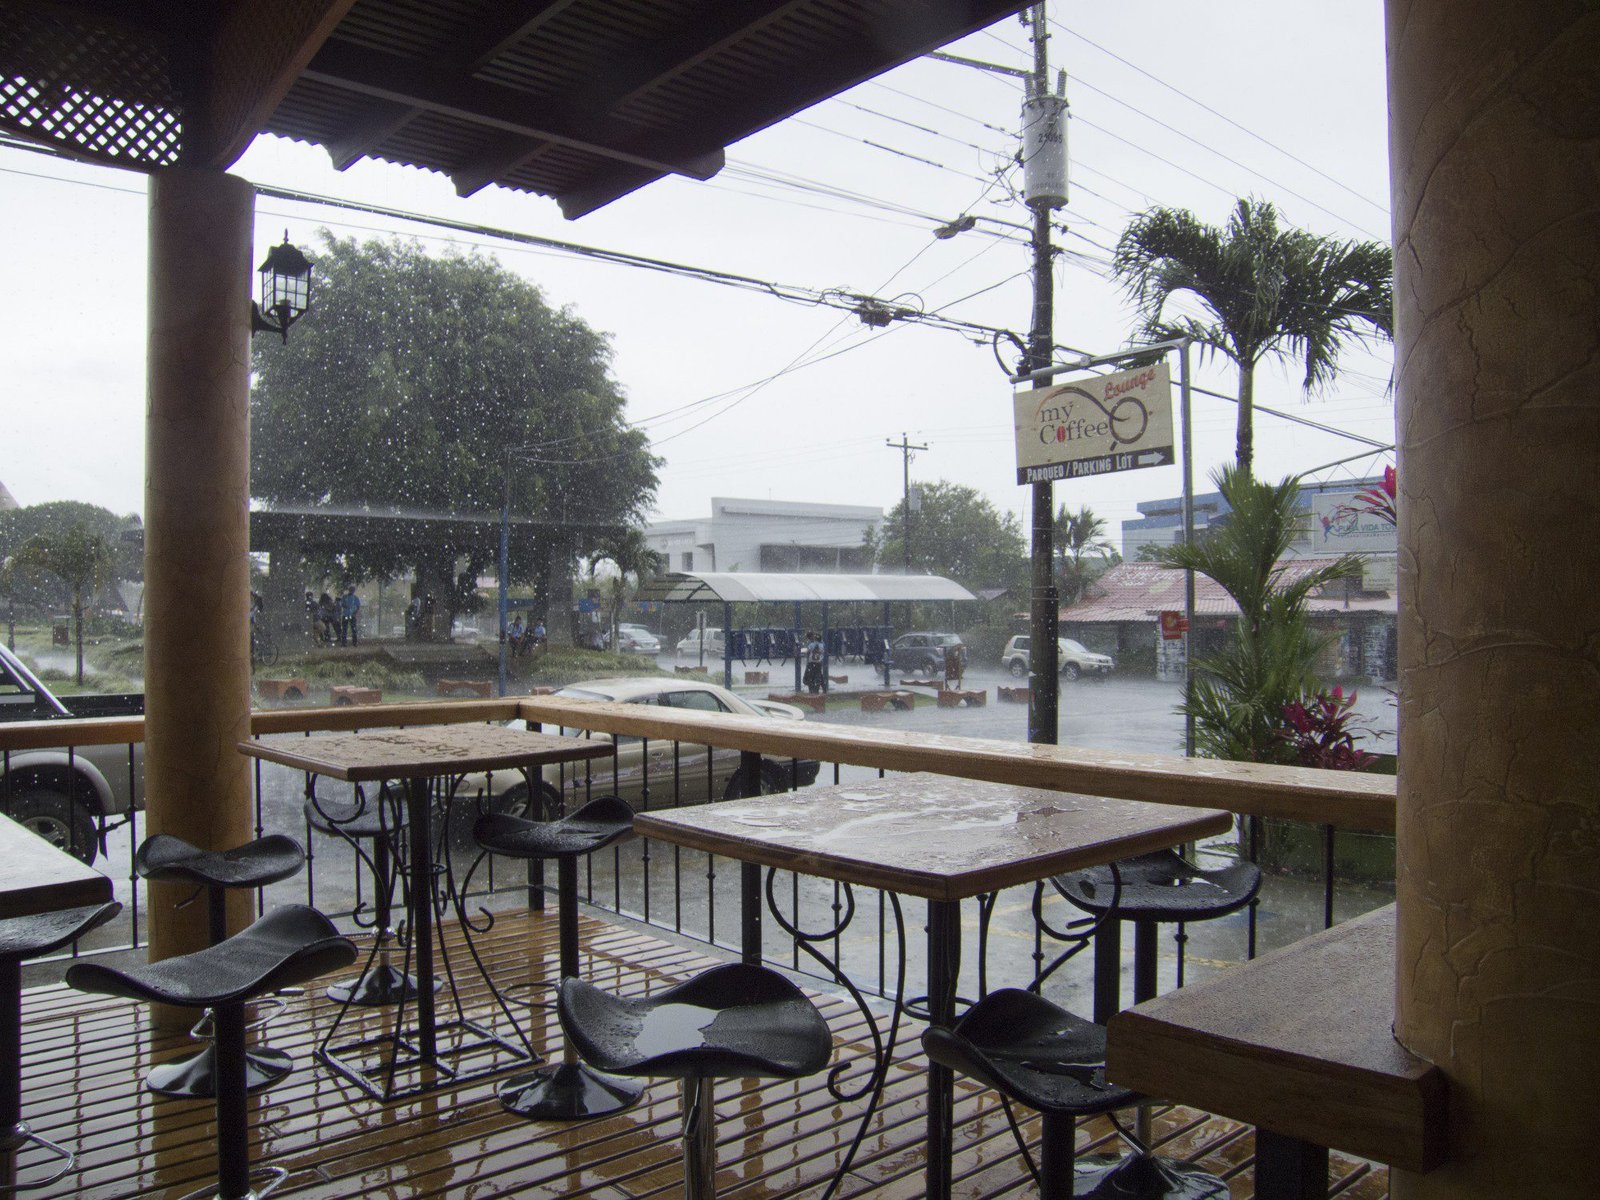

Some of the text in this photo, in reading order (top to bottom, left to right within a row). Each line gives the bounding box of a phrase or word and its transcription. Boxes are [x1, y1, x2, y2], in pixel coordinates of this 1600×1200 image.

[1041, 401, 1073, 423] my
[1027, 464, 1064, 482] PARQUEO
[1072, 458, 1112, 476] PARKING
[1116, 454, 1133, 470] LOT
[1361, 523, 1379, 532] VIDA
